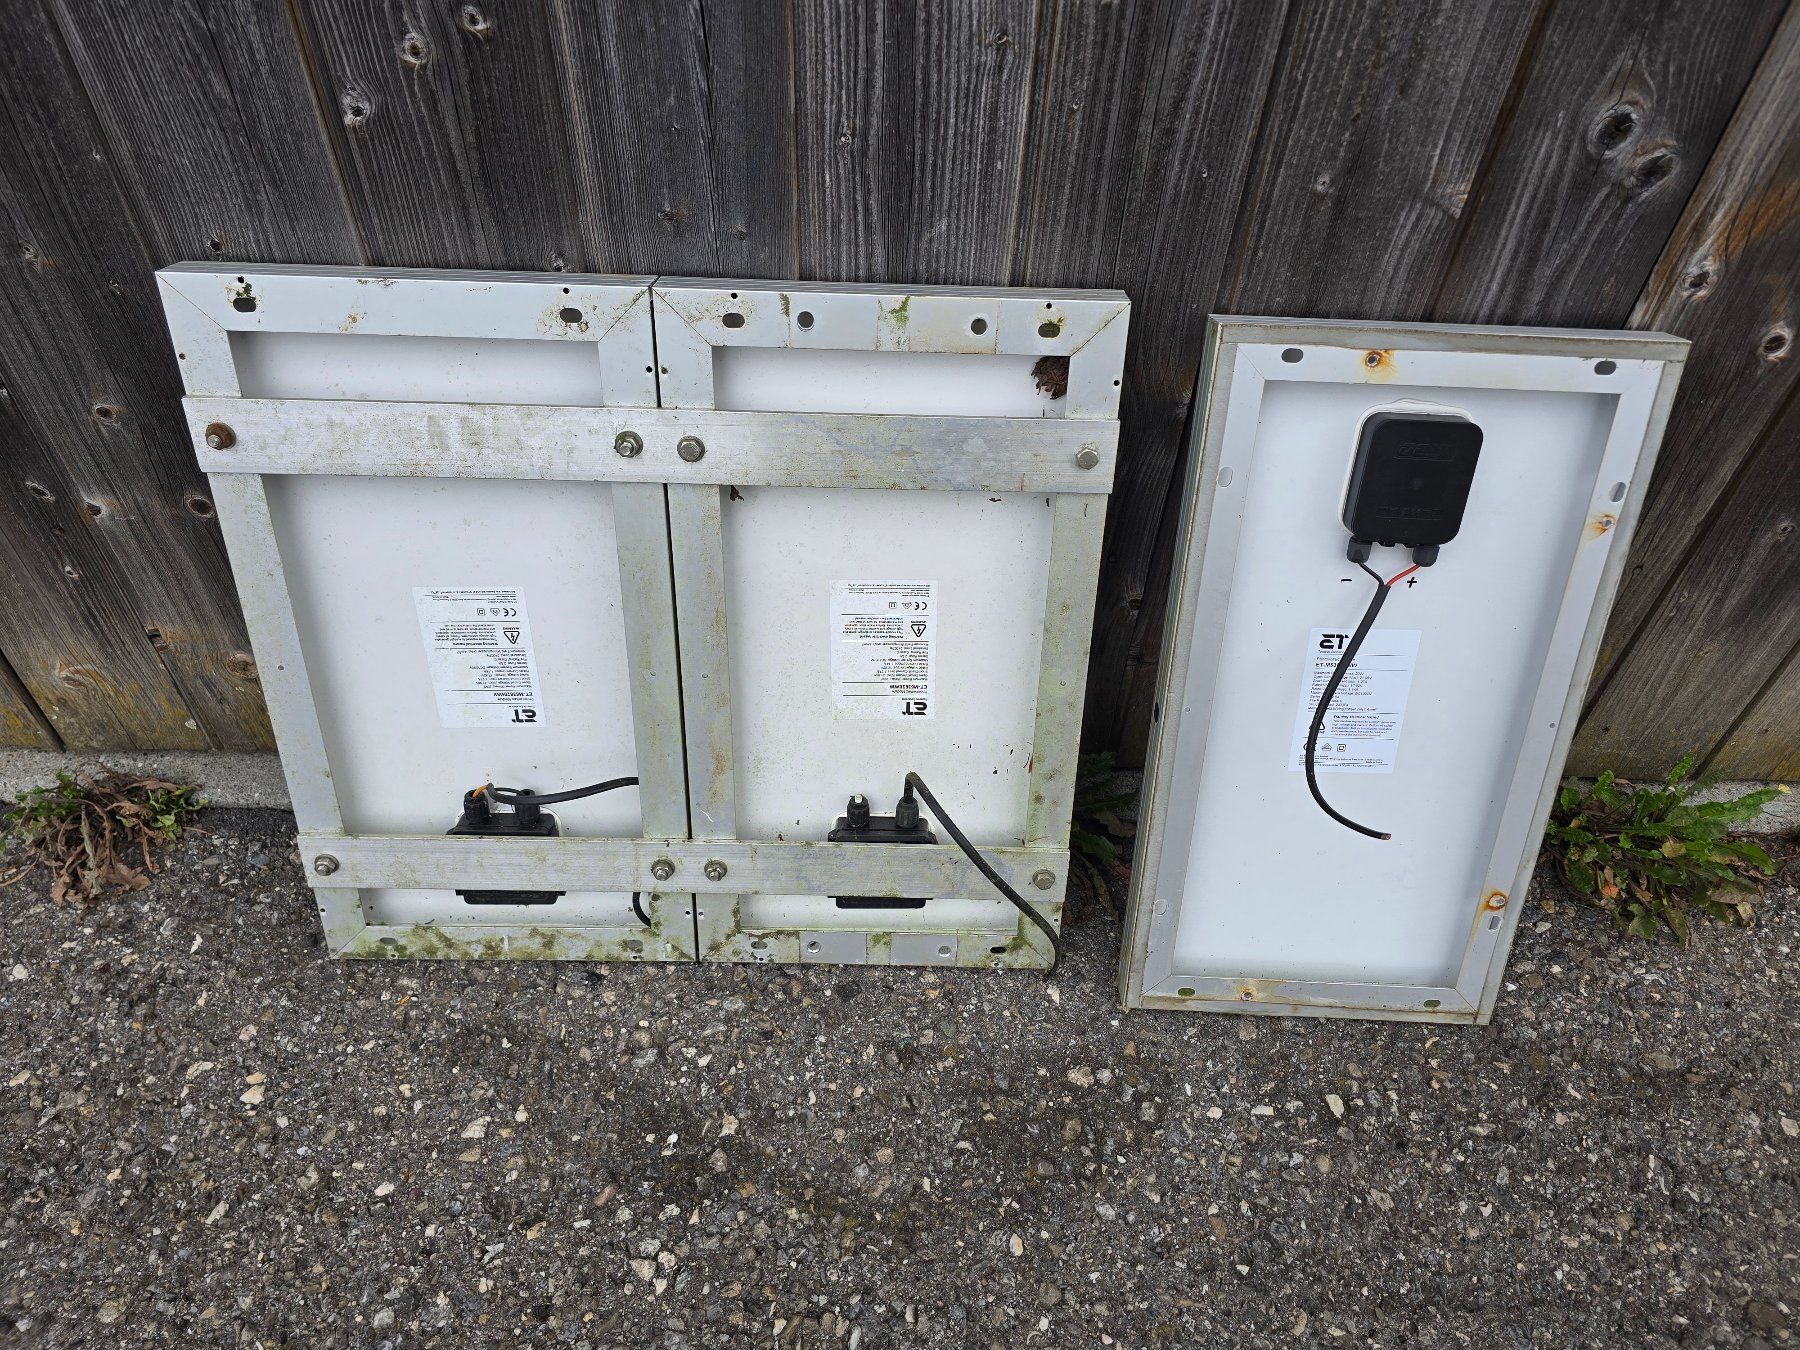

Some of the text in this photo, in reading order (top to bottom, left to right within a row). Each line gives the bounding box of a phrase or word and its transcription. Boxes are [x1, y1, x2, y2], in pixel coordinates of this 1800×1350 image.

[1319, 633, 1349, 649] ET
[511, 708, 537, 723] ET
[901, 701, 927, 715] ET
